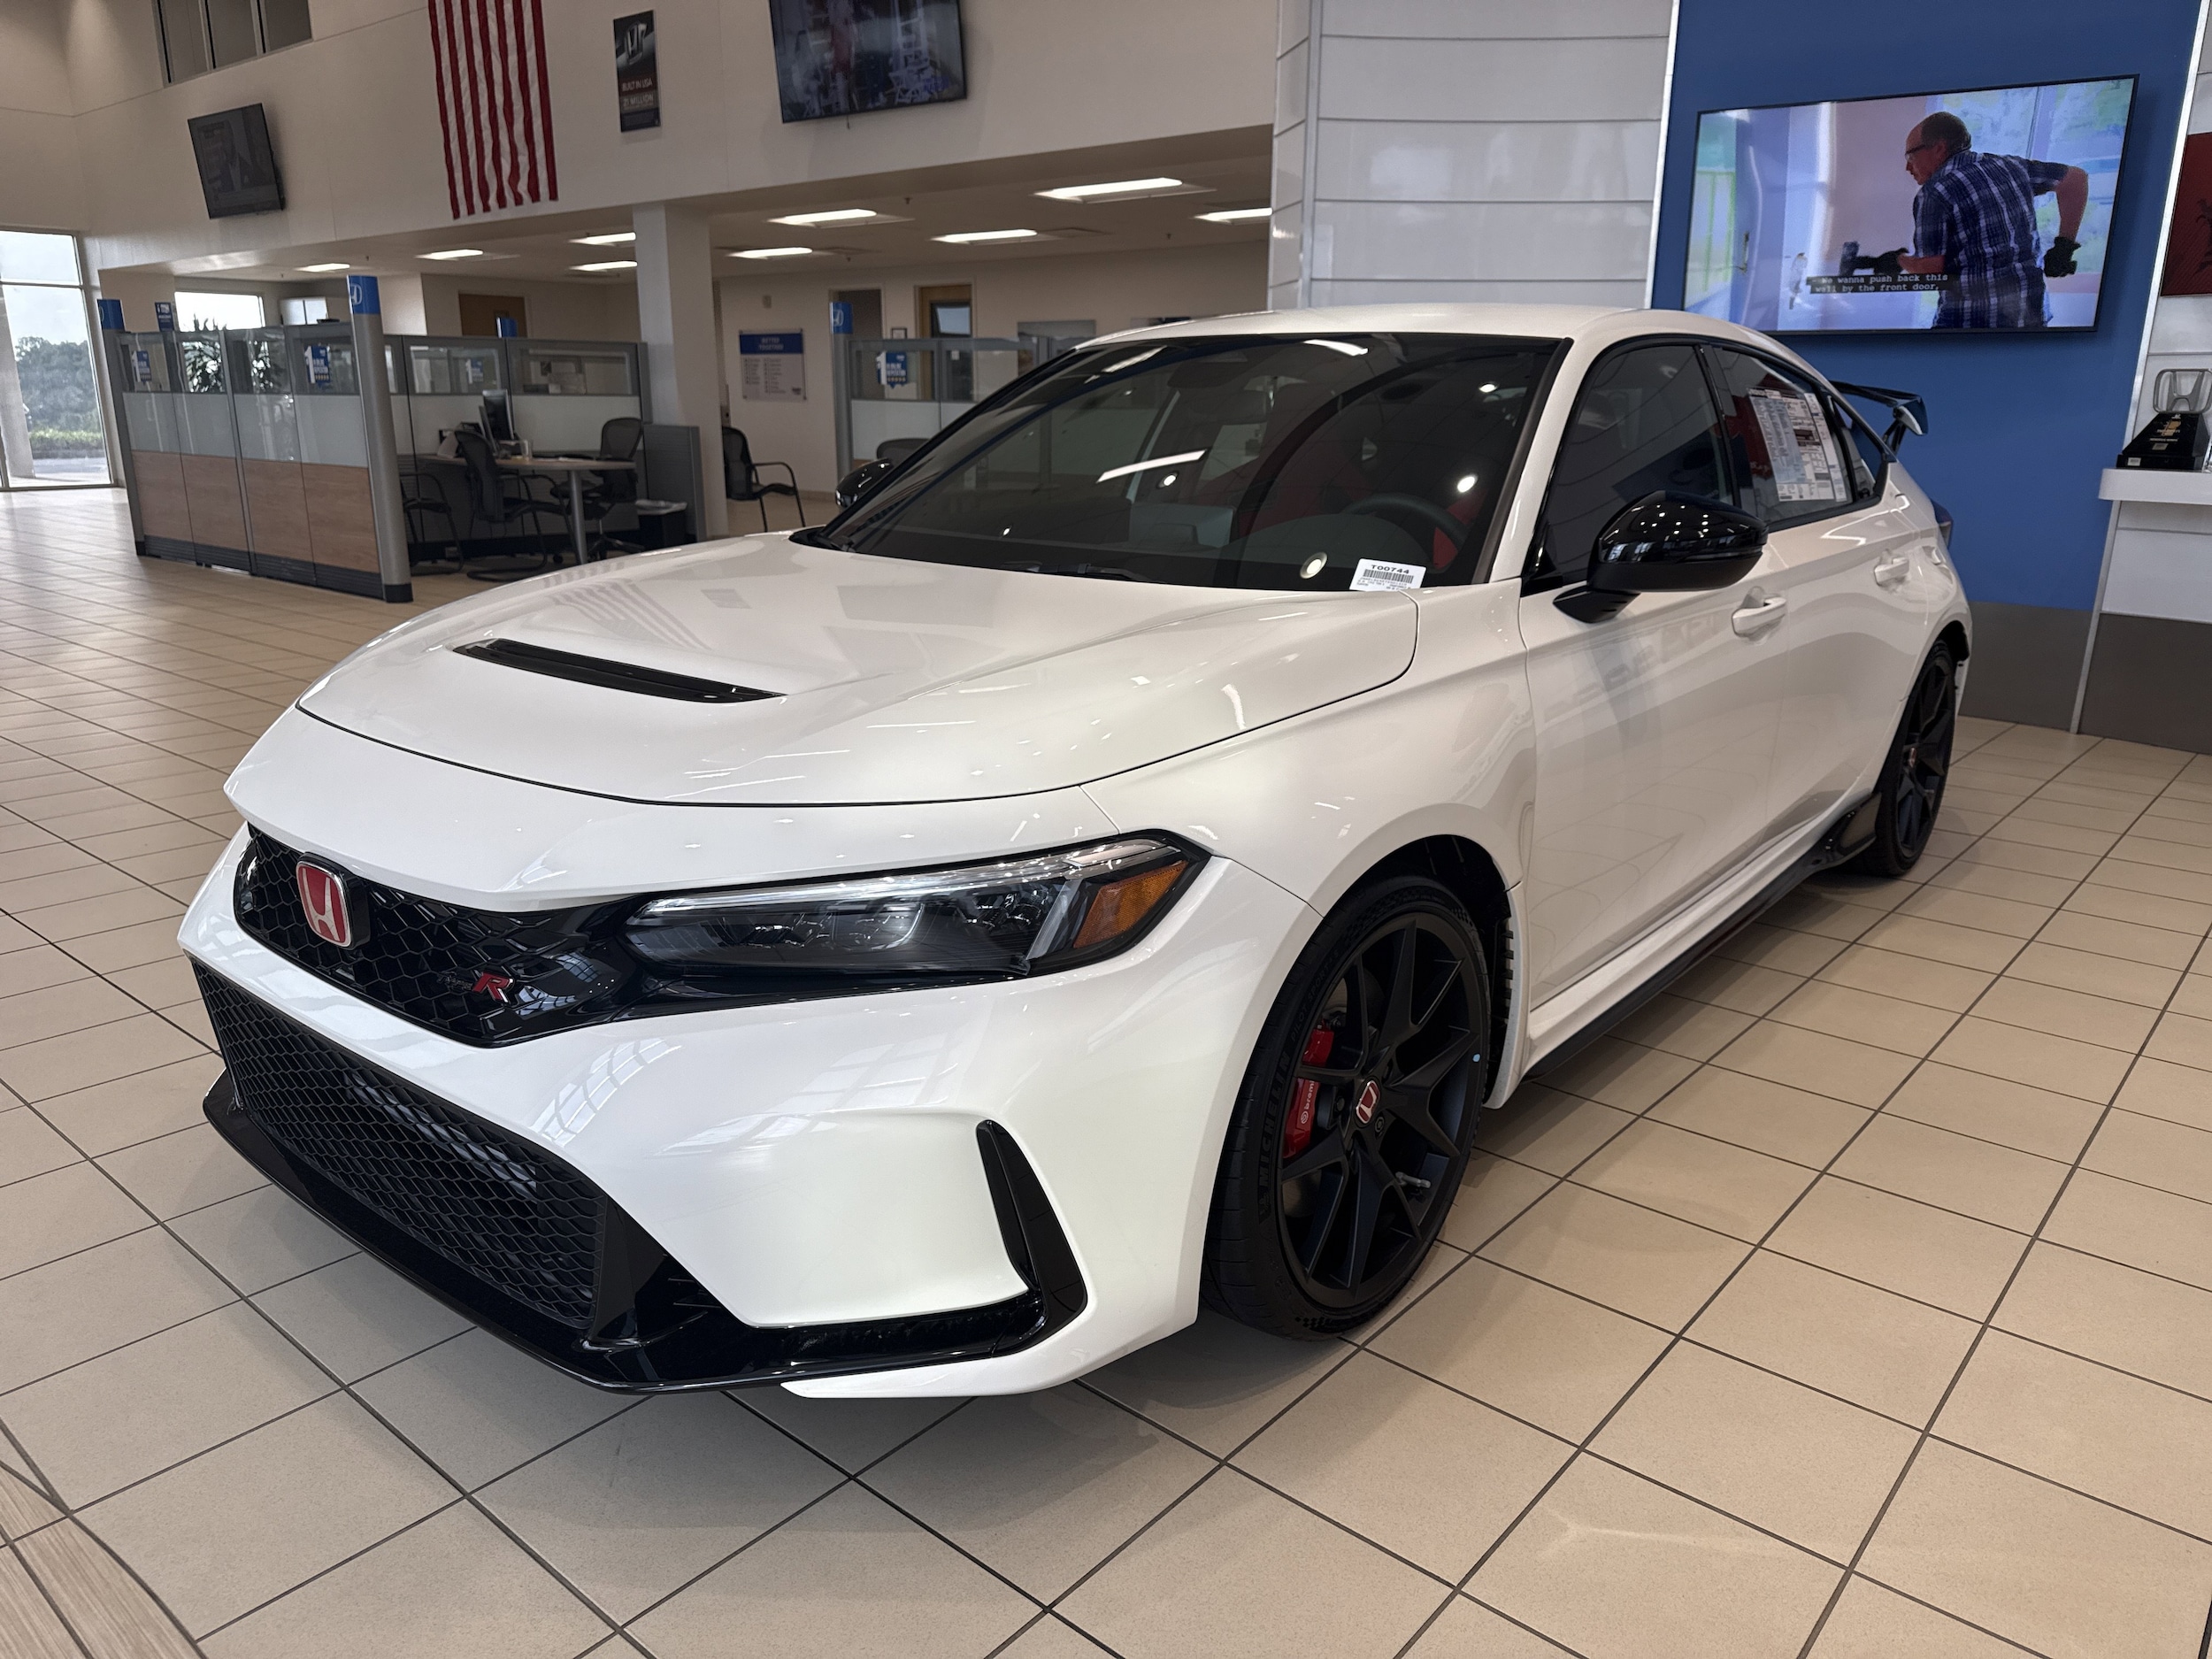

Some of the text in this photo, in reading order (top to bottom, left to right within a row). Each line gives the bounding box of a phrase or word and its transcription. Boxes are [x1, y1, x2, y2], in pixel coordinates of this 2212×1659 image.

[642, 78, 653, 88] USA
[630, 94, 653, 104] MILLION
[1870, 275, 1892, 284] push
[1304, 1079, 1316, 1110] brem
[1259, 1050, 1291, 1187] MICHELIN
